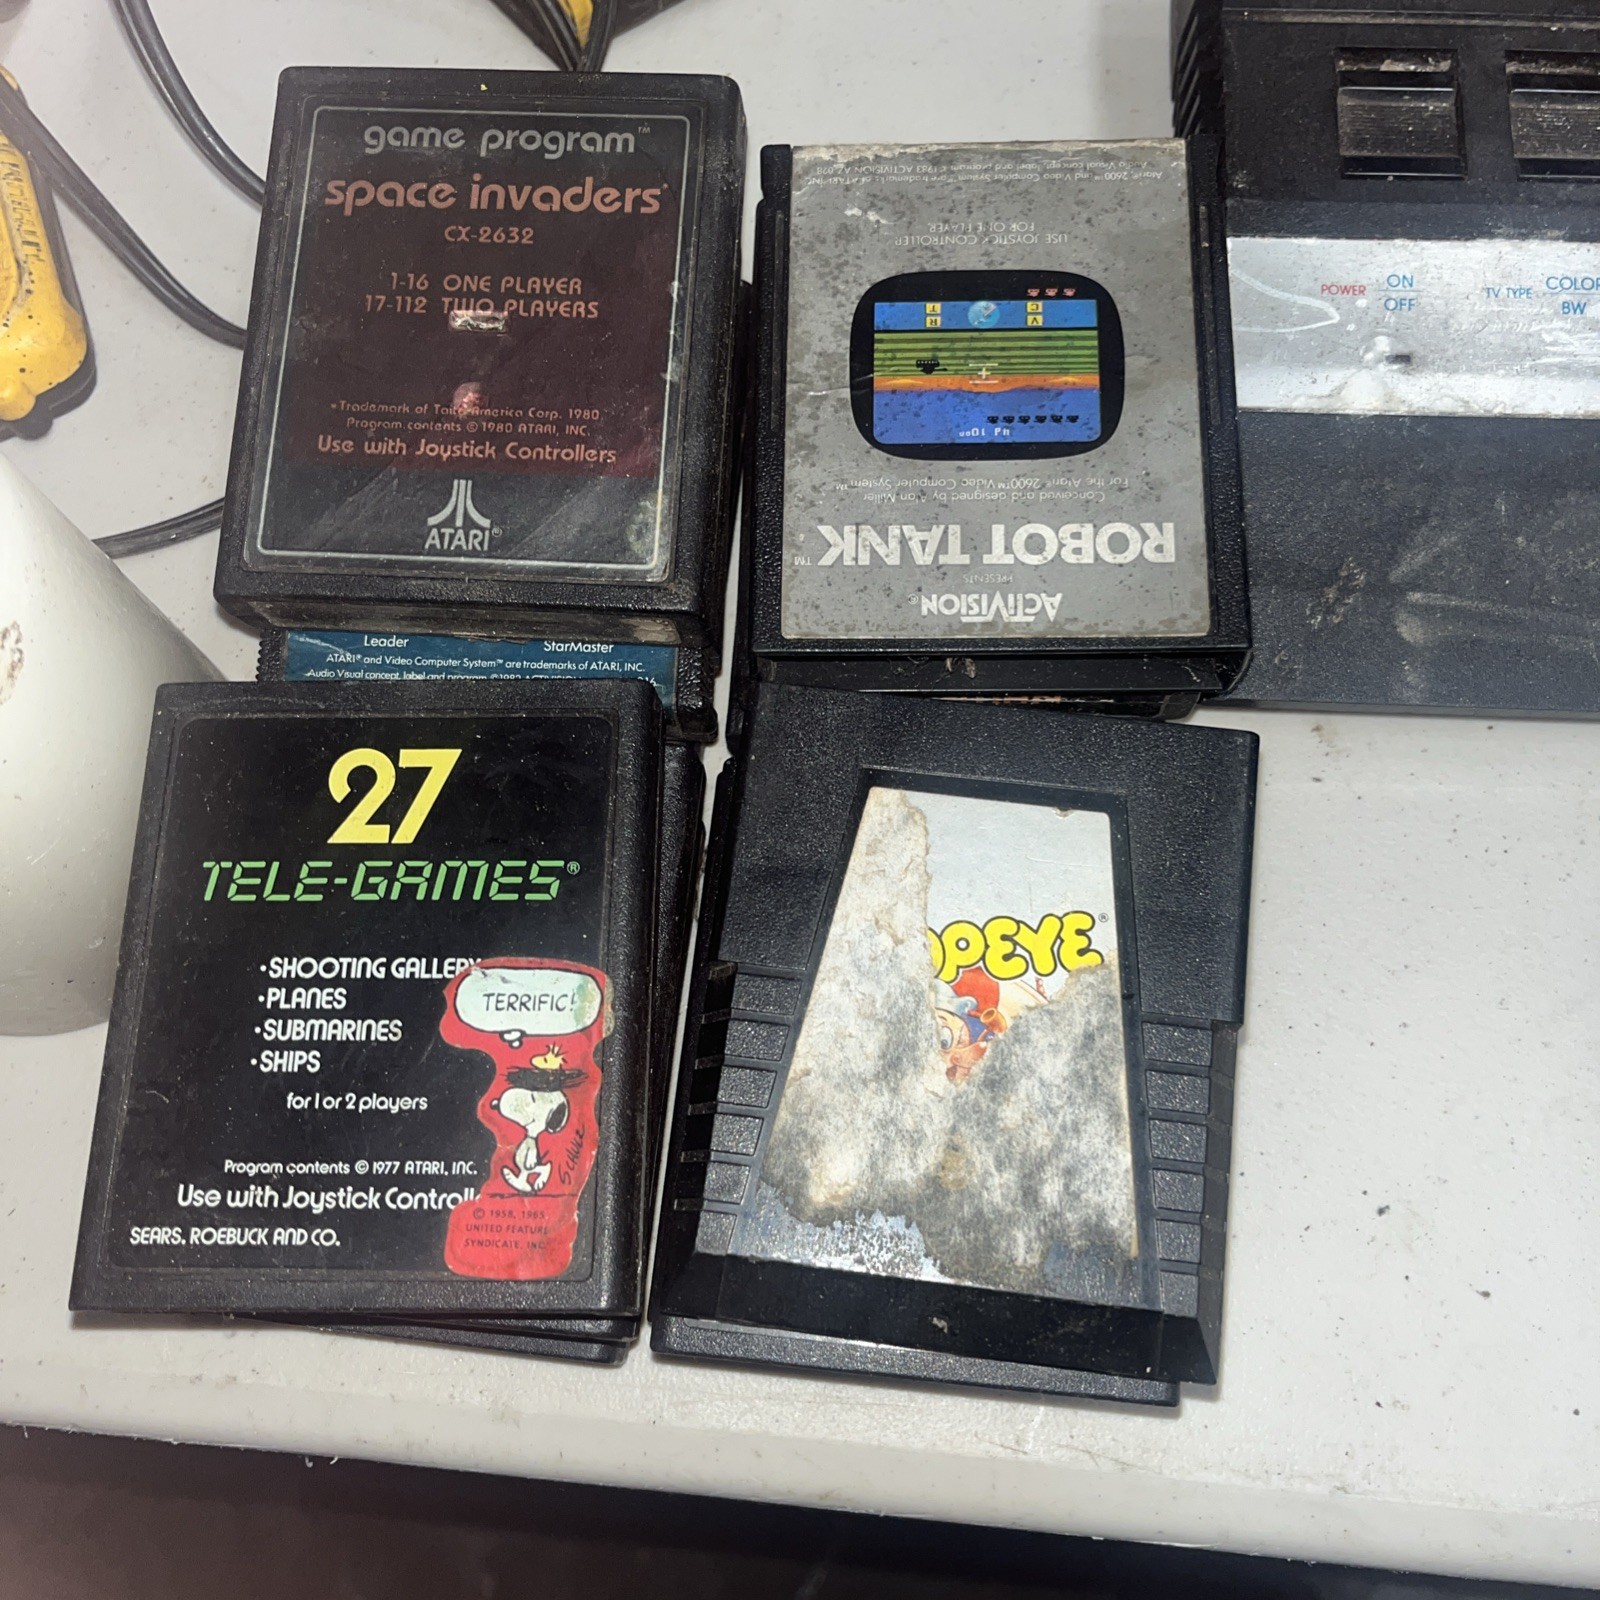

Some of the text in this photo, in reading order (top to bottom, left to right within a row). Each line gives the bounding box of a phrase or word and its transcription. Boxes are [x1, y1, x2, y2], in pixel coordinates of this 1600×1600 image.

[364, 126, 466, 155] game
[324, 180, 456, 217] space
[1008, 221, 1035, 232] FOR
[445, 226, 534, 244] CX-2632
[894, 233, 1068, 246] USE JOYSTICK CONTROLLER
[391, 272, 583, 295] 1-16 ONE PLAYER
[1386, 274, 1414, 288] ON
[1320, 284, 1367, 296] POWER
[1485, 287, 1532, 299] TV TYPE
[365, 295, 427, 314] 17-112
[504, 299, 599, 319] PLAYERS
[1384, 298, 1417, 311] OFF
[1562, 301, 1587, 315] BW
[415, 403, 428, 415] of
[470, 406, 524, 418] America
[528, 407, 562, 421] Corp.
[568, 408, 600, 420] 1980
[346, 416, 403, 431] Program
[407, 421, 462, 432] contents
[565, 424, 591, 437] INC.
[317, 434, 617, 463] Use with Joystick Controllers
[896, 477, 957, 490] Computer
[960, 478, 996, 490] Video
[1085, 477, 1105, 488] the
[1108, 477, 1129, 488] For
[863, 493, 896, 504] Miller
[932, 490, 947, 503] by
[952, 489, 1007, 503] designed
[1011, 492, 1035, 503] and
[1040, 491, 1105, 503] Conceived
[982, 521, 1176, 566] ROBOT
[962, 573, 1013, 584] PRESENTS
[363, 634, 410, 648] Leader
[543, 640, 615, 654] StarMaster
[363, 655, 382, 665] and
[384, 655, 413, 666] Video
[414, 656, 462, 668] Computer
[505, 660, 522, 669] are
[523, 659, 577, 671] trademarks
[578, 660, 589, 671] of
[589, 661, 622, 673] ATARI,
[624, 662, 646, 673] INC.
[308, 668, 336, 678] Audio
[337, 669, 364, 679] Visual
[403, 671, 426, 680] label
[327, 748, 462, 844] 27
[269, 957, 387, 979] SHOOTING
[266, 987, 347, 1009] PLANES
[482, 989, 576, 1012] TERRIFIC!
[263, 1018, 403, 1041] SUBMARINES
[259, 1050, 321, 1073] SHIPS
[286, 1092, 312, 1110] for
[322, 1097, 342, 1110] or
[345, 1093, 357, 1110] 2
[358, 1093, 428, 1113] players
[224, 1159, 284, 1177] Program
[285, 1161, 351, 1175] contents
[372, 1161, 400, 1175] 1977
[177, 1183, 481, 1214] Use with Joystick Controll
[465, 1223, 503, 1233] UNITED
[189, 1227, 269, 1246] ROEBUCK
[272, 1228, 308, 1246] AND
[311, 1228, 341, 1247] CO.
